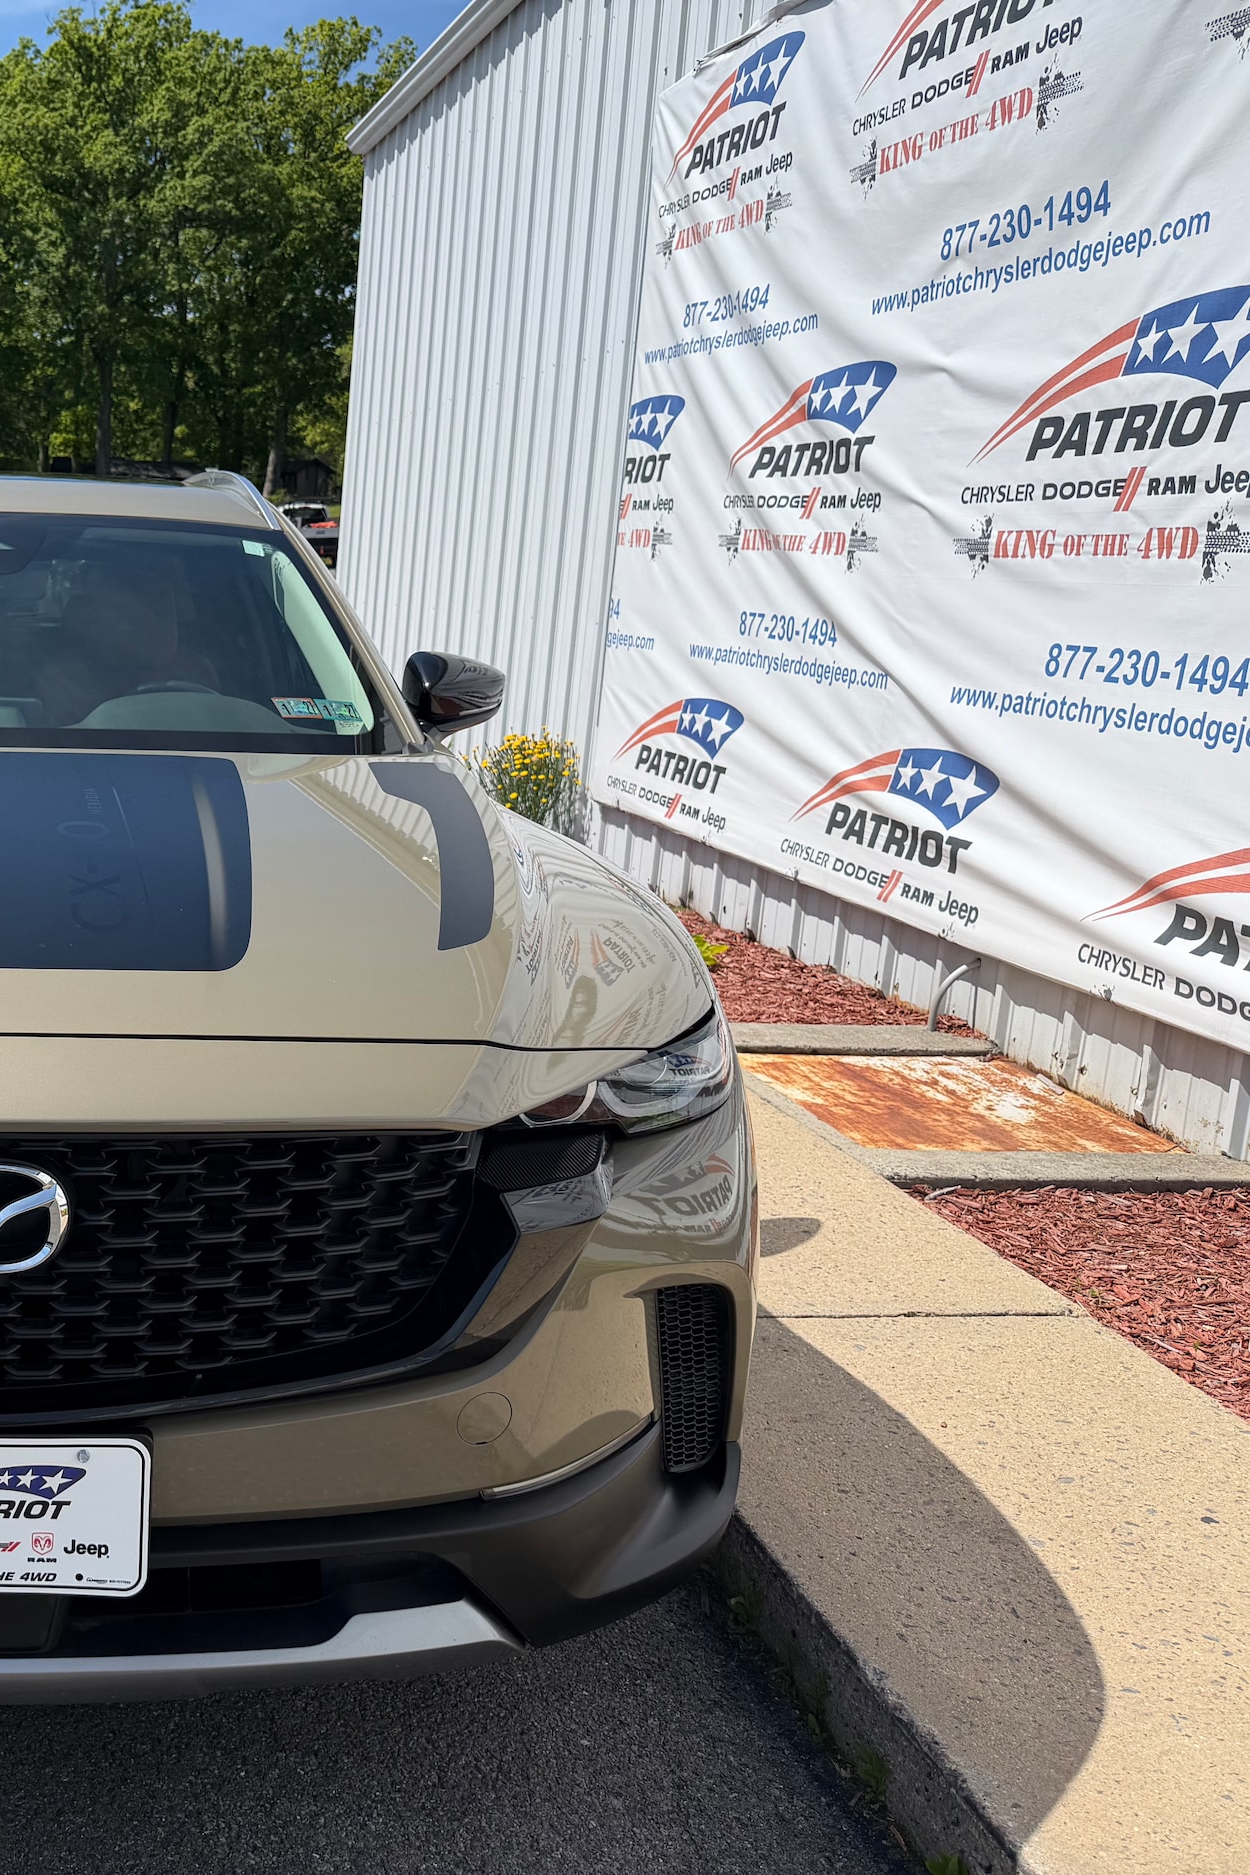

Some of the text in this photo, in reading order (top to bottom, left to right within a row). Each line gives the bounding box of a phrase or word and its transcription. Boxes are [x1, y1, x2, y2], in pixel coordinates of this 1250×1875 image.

[852, 16, 1083, 136] CHRYSLER DODGE RAM Jeep
[684, 101, 787, 180] PATRIOT
[879, 87, 1034, 175] KING OF THE 4WD
[658, 151, 793, 218] CHRYSLER DODGE RAM Jeep
[675, 199, 764, 250] KING OF THE 4WD
[940, 179, 1112, 261] 877-230-1494
[871, 211, 1211, 315] www.patriotchryslerdodgejeep.com
[683, 283, 770, 328] 877-230-1494
[644, 313, 818, 364] www.patriotchryslerdodgejeep.com
[1025, 389, 1250, 462] PATRIOT
[748, 435, 875, 479] PATRIOT
[632, 500, 650, 511] RAM
[652, 494, 674, 514] Jeep
[757, 495, 810, 509] DODGE
[819, 494, 847, 509] RAM
[850, 487, 882, 513] Jeep
[961, 463, 1250, 505] CHRYSLER DODGE RAM Jee
[628, 529, 650, 548] 4WD
[740, 529, 771, 551] KING
[782, 534, 806, 552] THE
[809, 531, 847, 556] 4WD
[993, 526, 1199, 560] KING OF THE 4WD
[738, 611, 837, 648] 877-230-1494
[689, 642, 888, 690] www.patriotchryslerdodgejeep.com
[1044, 642, 1250, 697] 877-230-1494
[950, 685, 1250, 753] www.patriotchryslerdodgej
[634, 744, 726, 794] PATRIOT
[606, 775, 726, 833] CHRYSLER DODGE RAM Jeep
[825, 802, 973, 874] PATRIOT
[780, 838, 979, 927] CHRYSLER DODGE RAM Jeep
[1077, 943, 1165, 990] CHRYSLER
[63, 1539, 109, 1558] Jeep
[19, 1572, 57, 1582] 4WD
